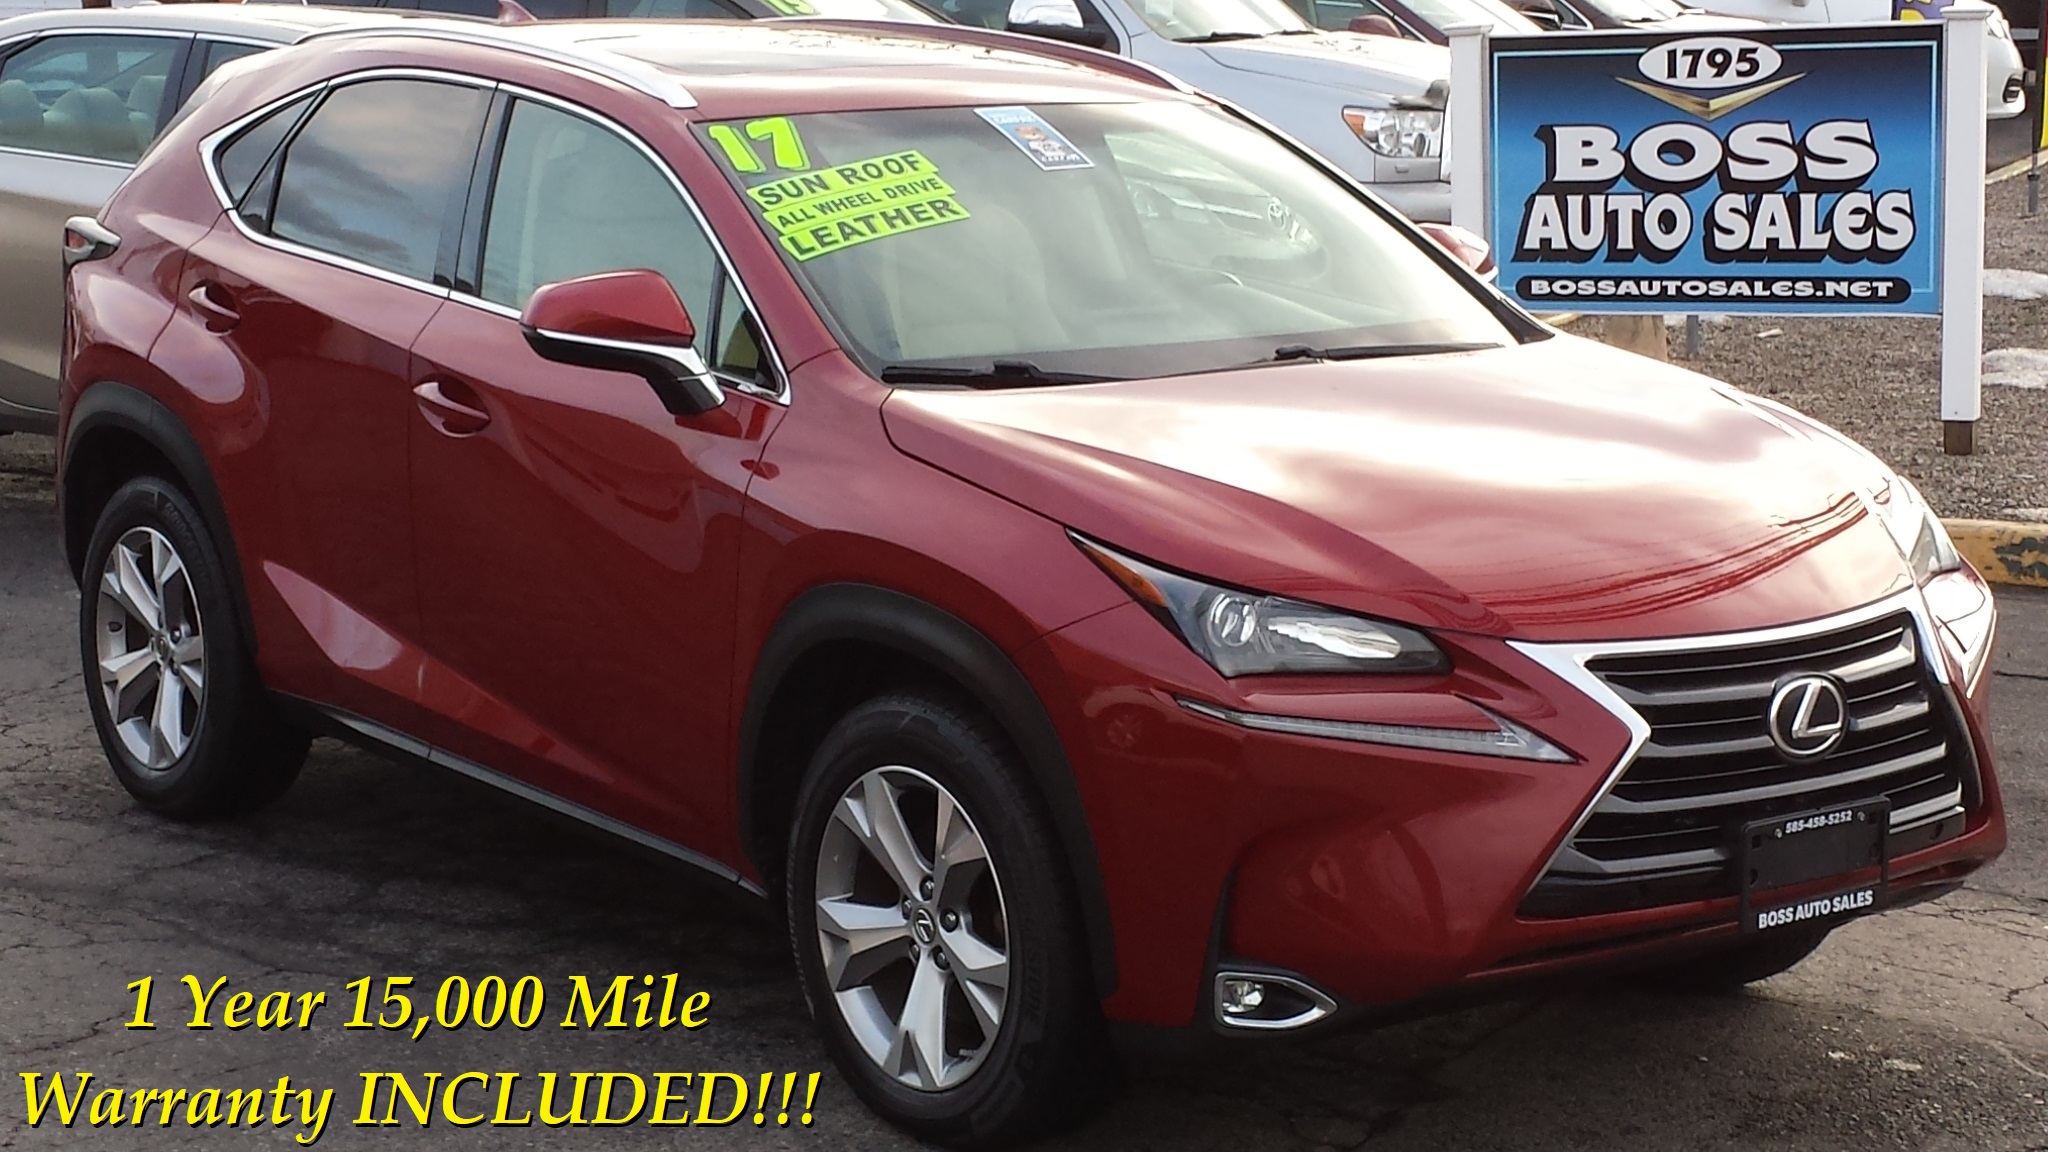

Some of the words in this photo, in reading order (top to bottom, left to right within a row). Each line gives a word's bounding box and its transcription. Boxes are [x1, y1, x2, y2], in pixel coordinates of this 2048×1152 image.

[1665, 46, 1761, 80] 1795
[708, 117, 812, 173] 17
[1546, 121, 1878, 185] BOSS
[757, 174, 831, 206] SUN
[836, 153, 922, 186] ROOF
[777, 209, 814, 228] ALL
[814, 191, 881, 216] WHEEL
[883, 177, 944, 199] DRIVE
[787, 198, 961, 256] LEATHER
[1518, 193, 1692, 254] AUTO
[1708, 191, 1914, 256] SALES
[1530, 278, 1895, 299] BOSSAUTOSALES.NET
[1758, 907, 1794, 929] BOSS
[1795, 899, 1831, 921] AUTO
[1832, 890, 1873, 913] SALES
